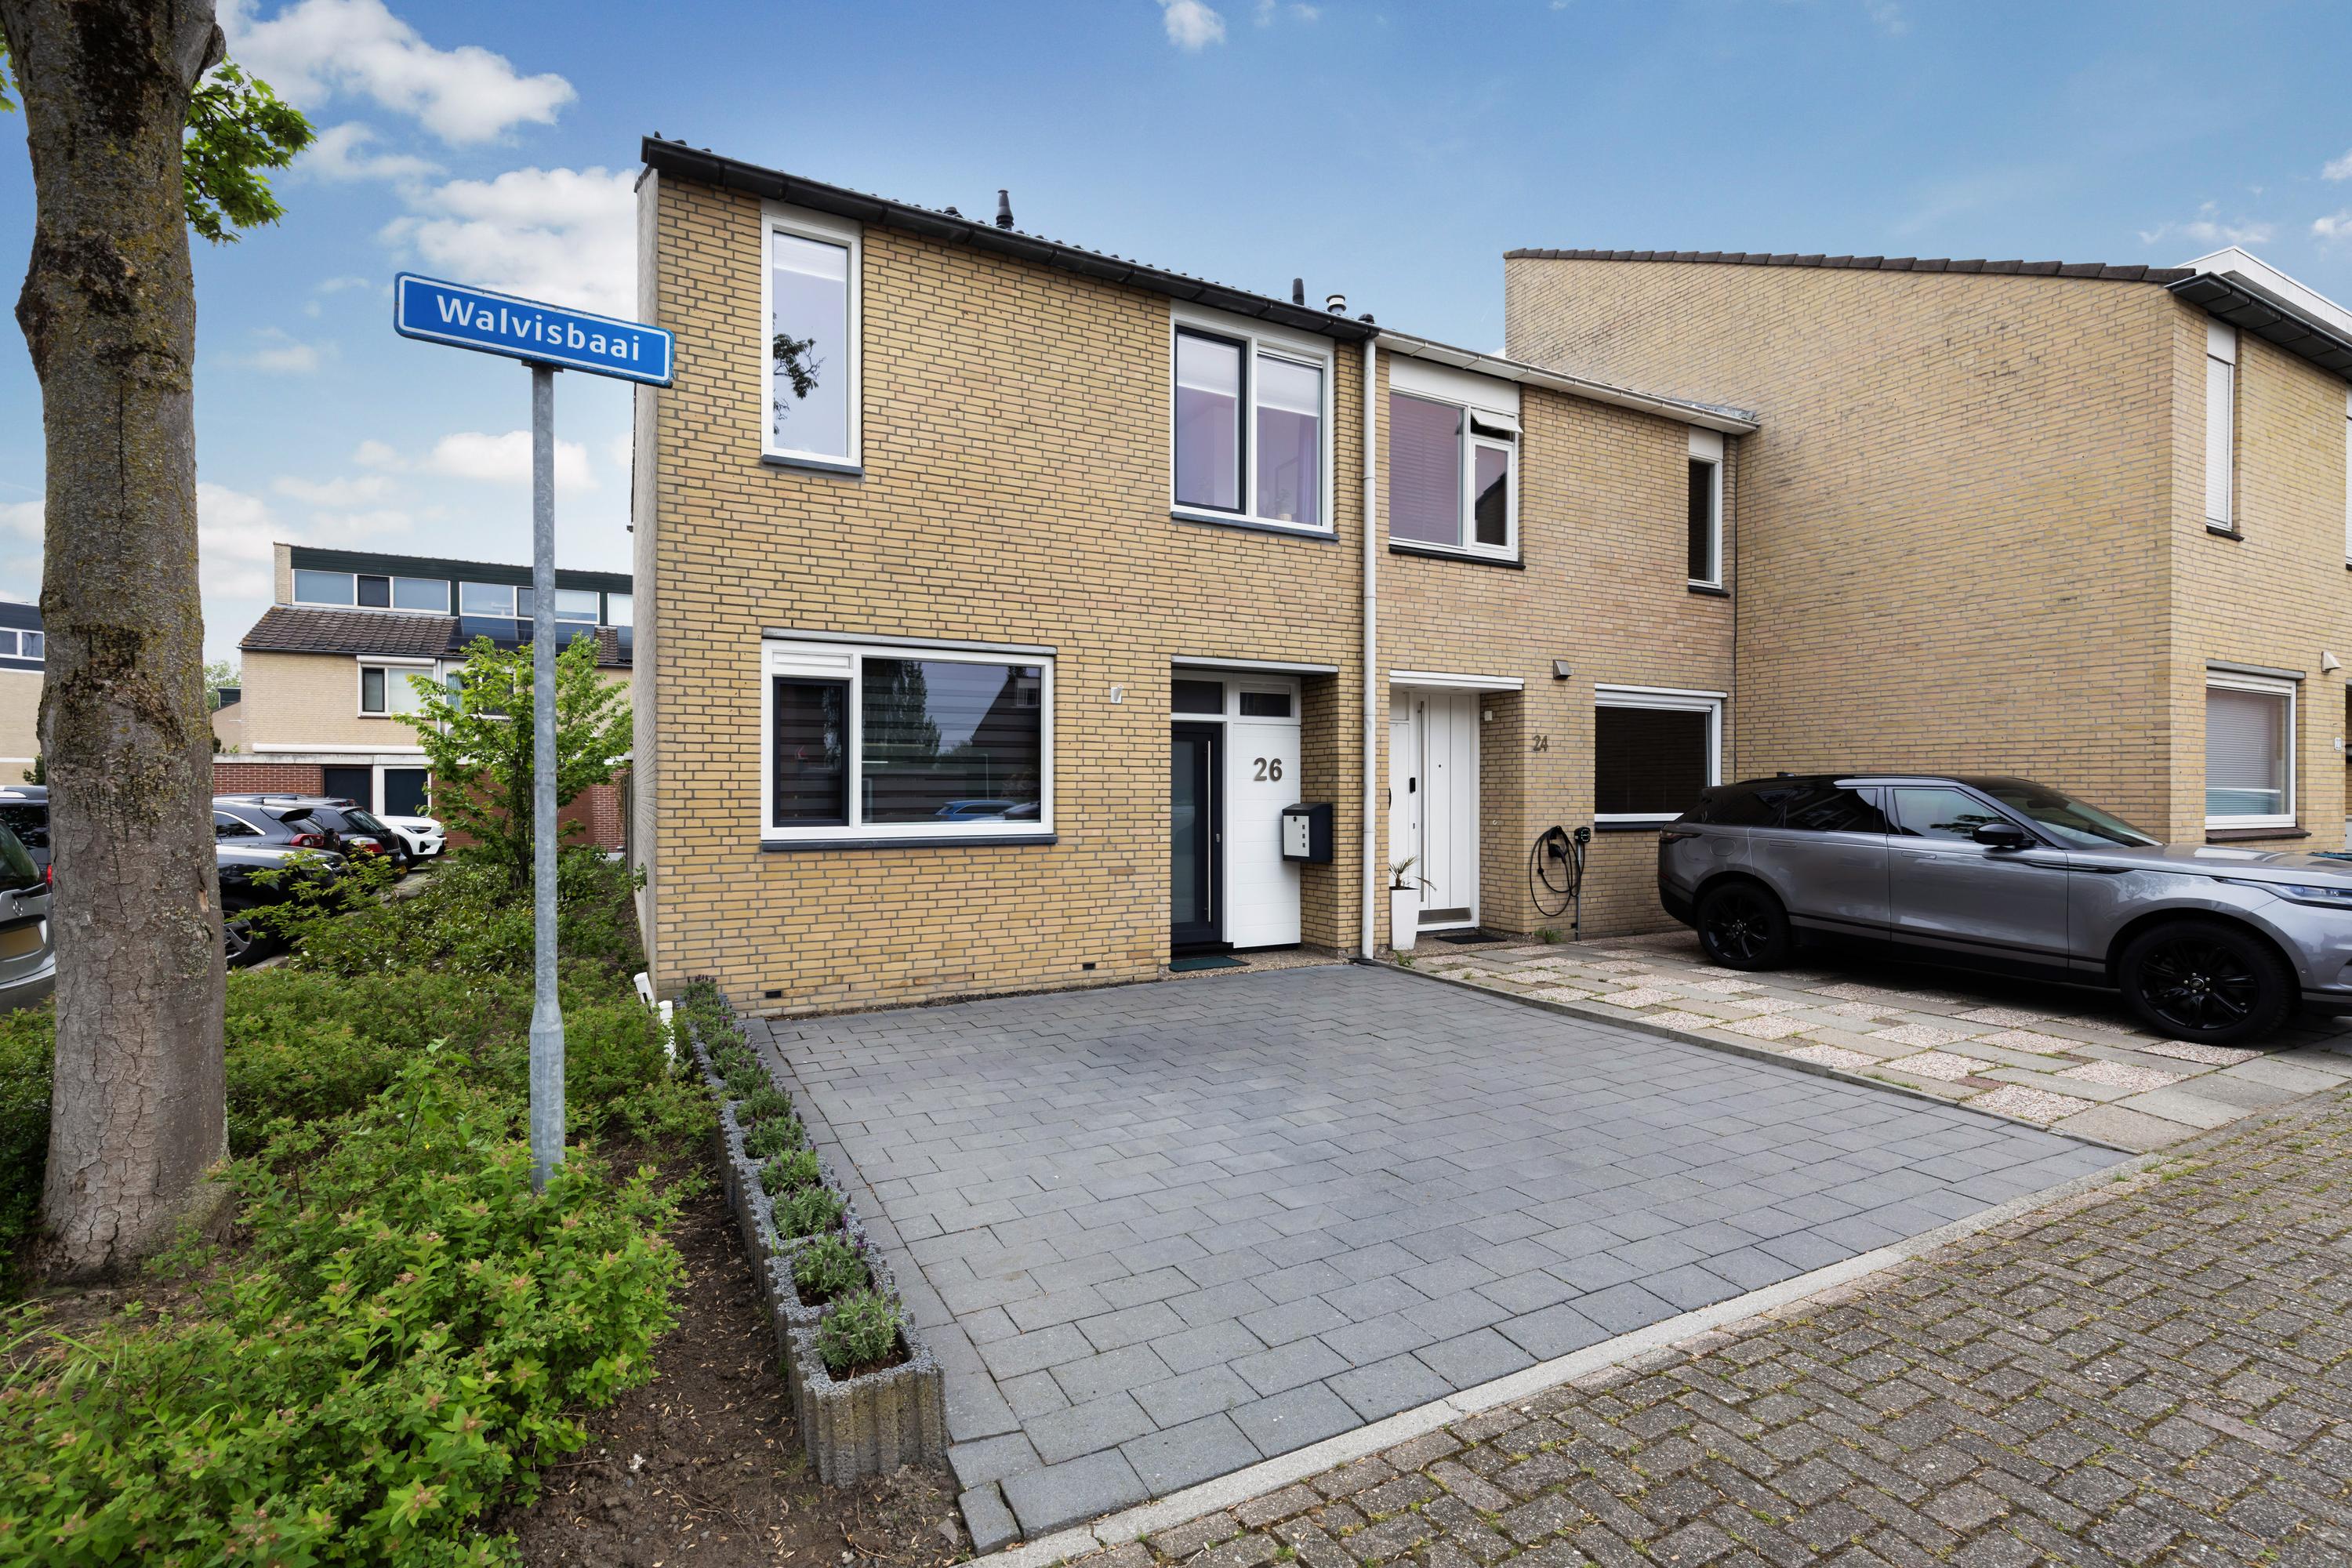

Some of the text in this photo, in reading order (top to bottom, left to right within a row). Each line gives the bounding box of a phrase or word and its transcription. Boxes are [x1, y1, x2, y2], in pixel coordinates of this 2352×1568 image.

[437, 295, 639, 361] Walvisbaai
[1533, 735, 1548, 752] 24
[1254, 757, 1283, 782] 26
